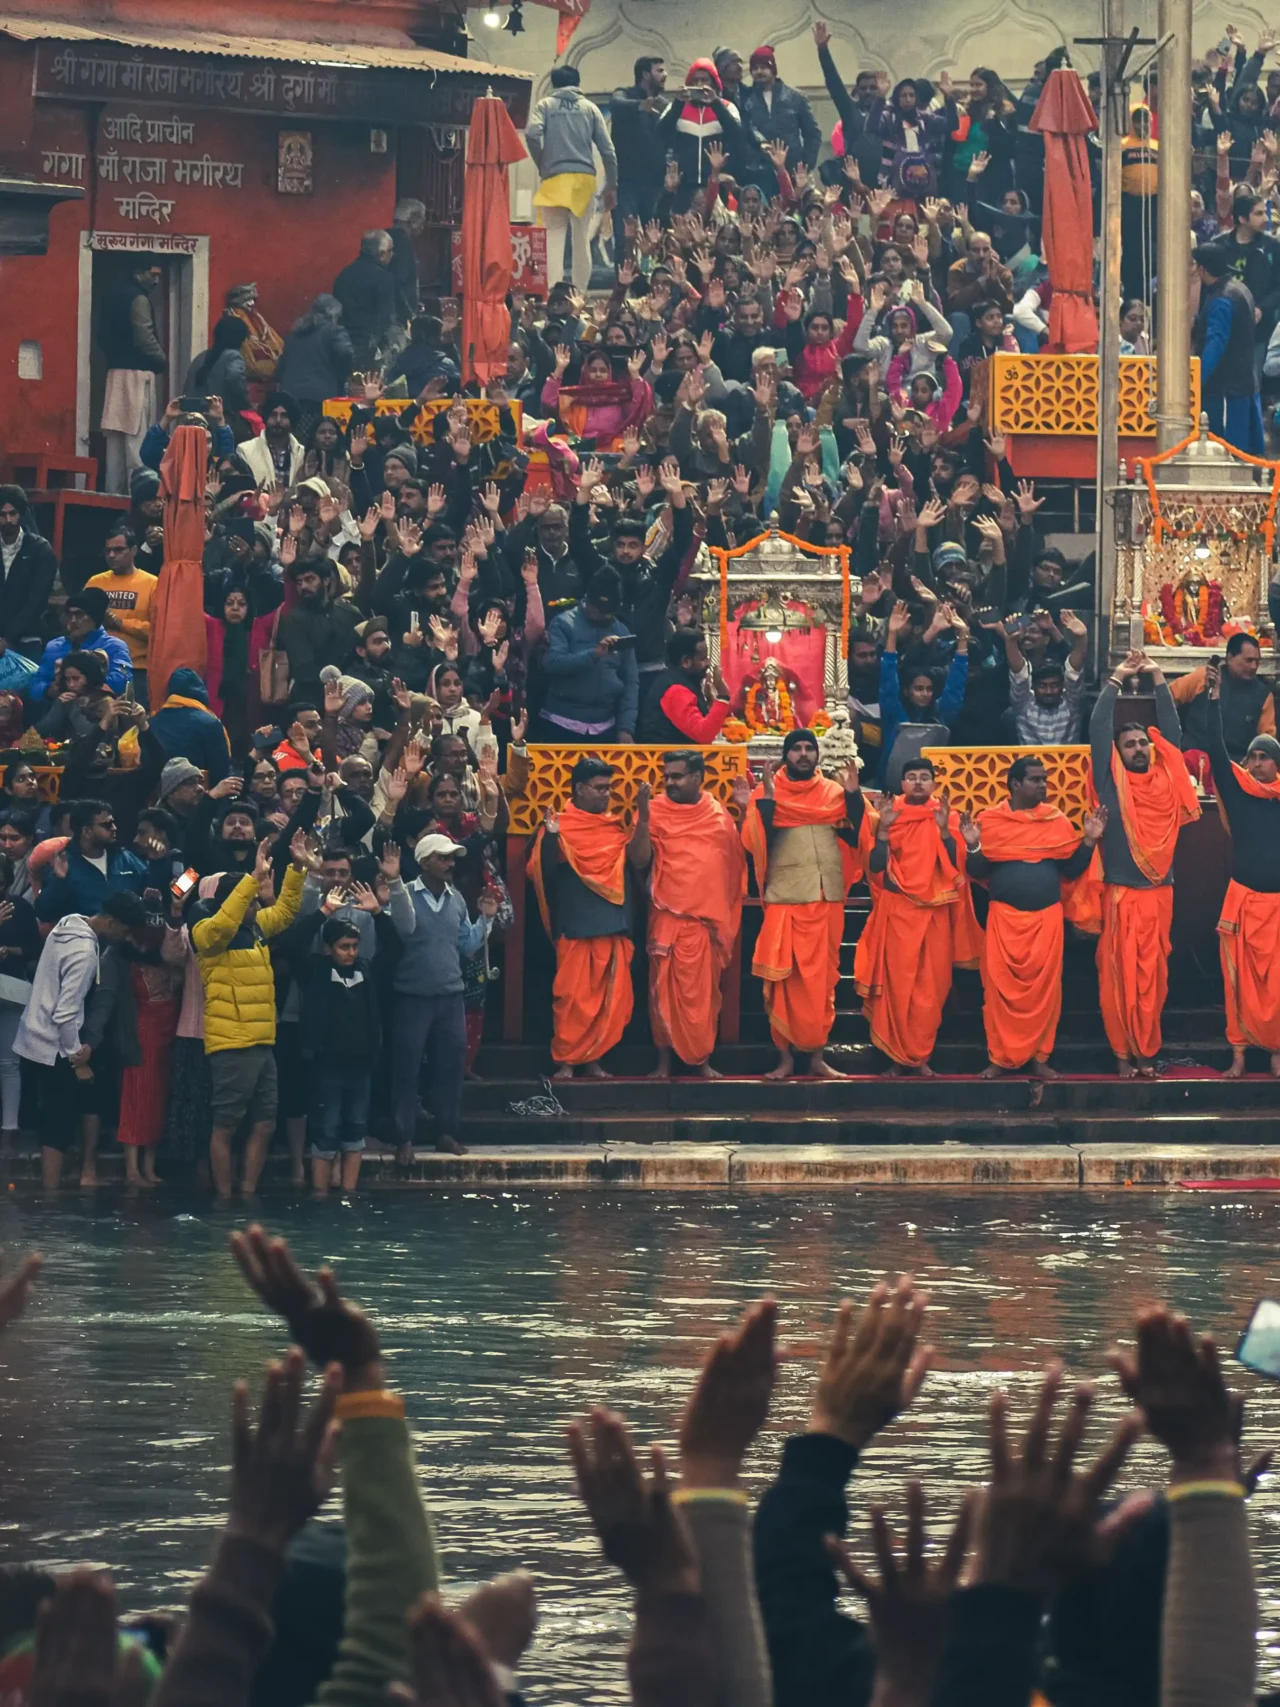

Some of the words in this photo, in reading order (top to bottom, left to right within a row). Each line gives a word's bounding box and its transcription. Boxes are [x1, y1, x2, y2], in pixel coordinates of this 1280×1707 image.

[103, 113, 143, 144] आदि
[145, 115, 196, 146] प्राचीन
[41, 145, 87, 180] गंगा
[97, 146, 120, 183] माँ
[120, 155, 168, 185] राजा
[172, 153, 245, 189] भगीरथ
[113, 191, 177, 225] मन्दिर
[127, 232, 155, 249] गंगा
[106, 591, 135, 600] NITED
